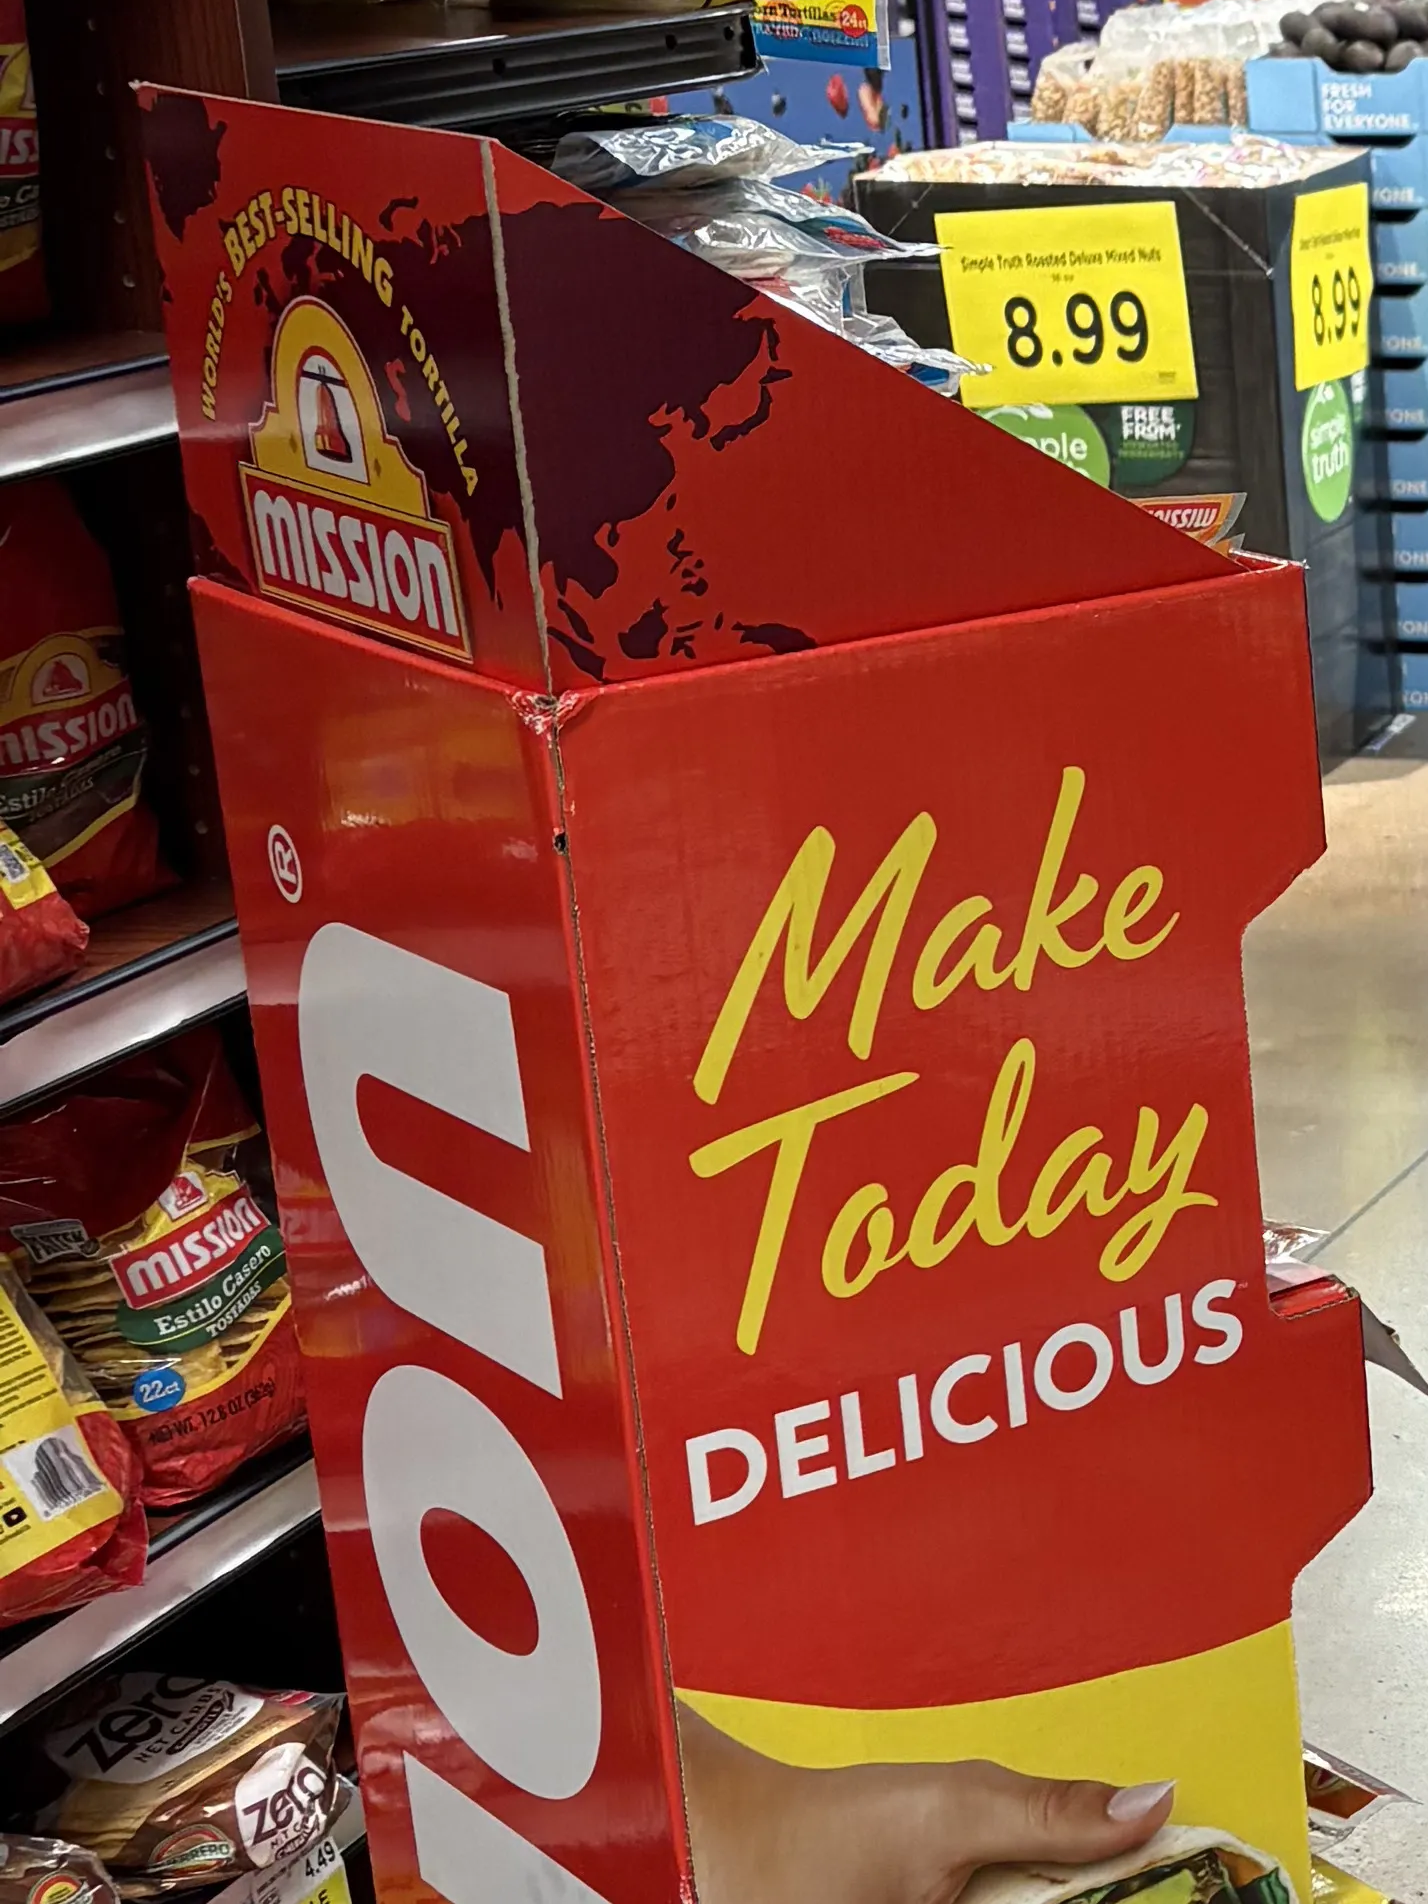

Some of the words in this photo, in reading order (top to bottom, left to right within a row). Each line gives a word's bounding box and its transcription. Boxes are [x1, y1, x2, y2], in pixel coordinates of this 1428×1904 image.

[201, 270, 233, 423] WORLD'S
[221, 185, 395, 308] BEST-SELLING
[400, 304, 481, 498] TORTILLA
[1003, 289, 1151, 370] 8.99
[1311, 264, 1363, 347] 8.99
[1120, 406, 1176, 423] FREE
[1311, 442, 1350, 485] truth
[253, 489, 460, 638] MISSION
[691, 765, 1181, 1105] Make
[688, 1037, 1221, 1358] Today
[125, 1194, 264, 1299] MISSION
[151, 1292, 224, 1339] Estilo
[219, 1243, 273, 1301] Casero
[204, 1279, 263, 1340] TOSTADAS
[139, 1377, 182, 1406] 22ct
[684, 1278, 1225, 1527] DELICIOUS
[133, 1734, 169, 1765] NET
[242, 1764, 329, 1846] zero
[304, 1840, 337, 1878] 4.49
